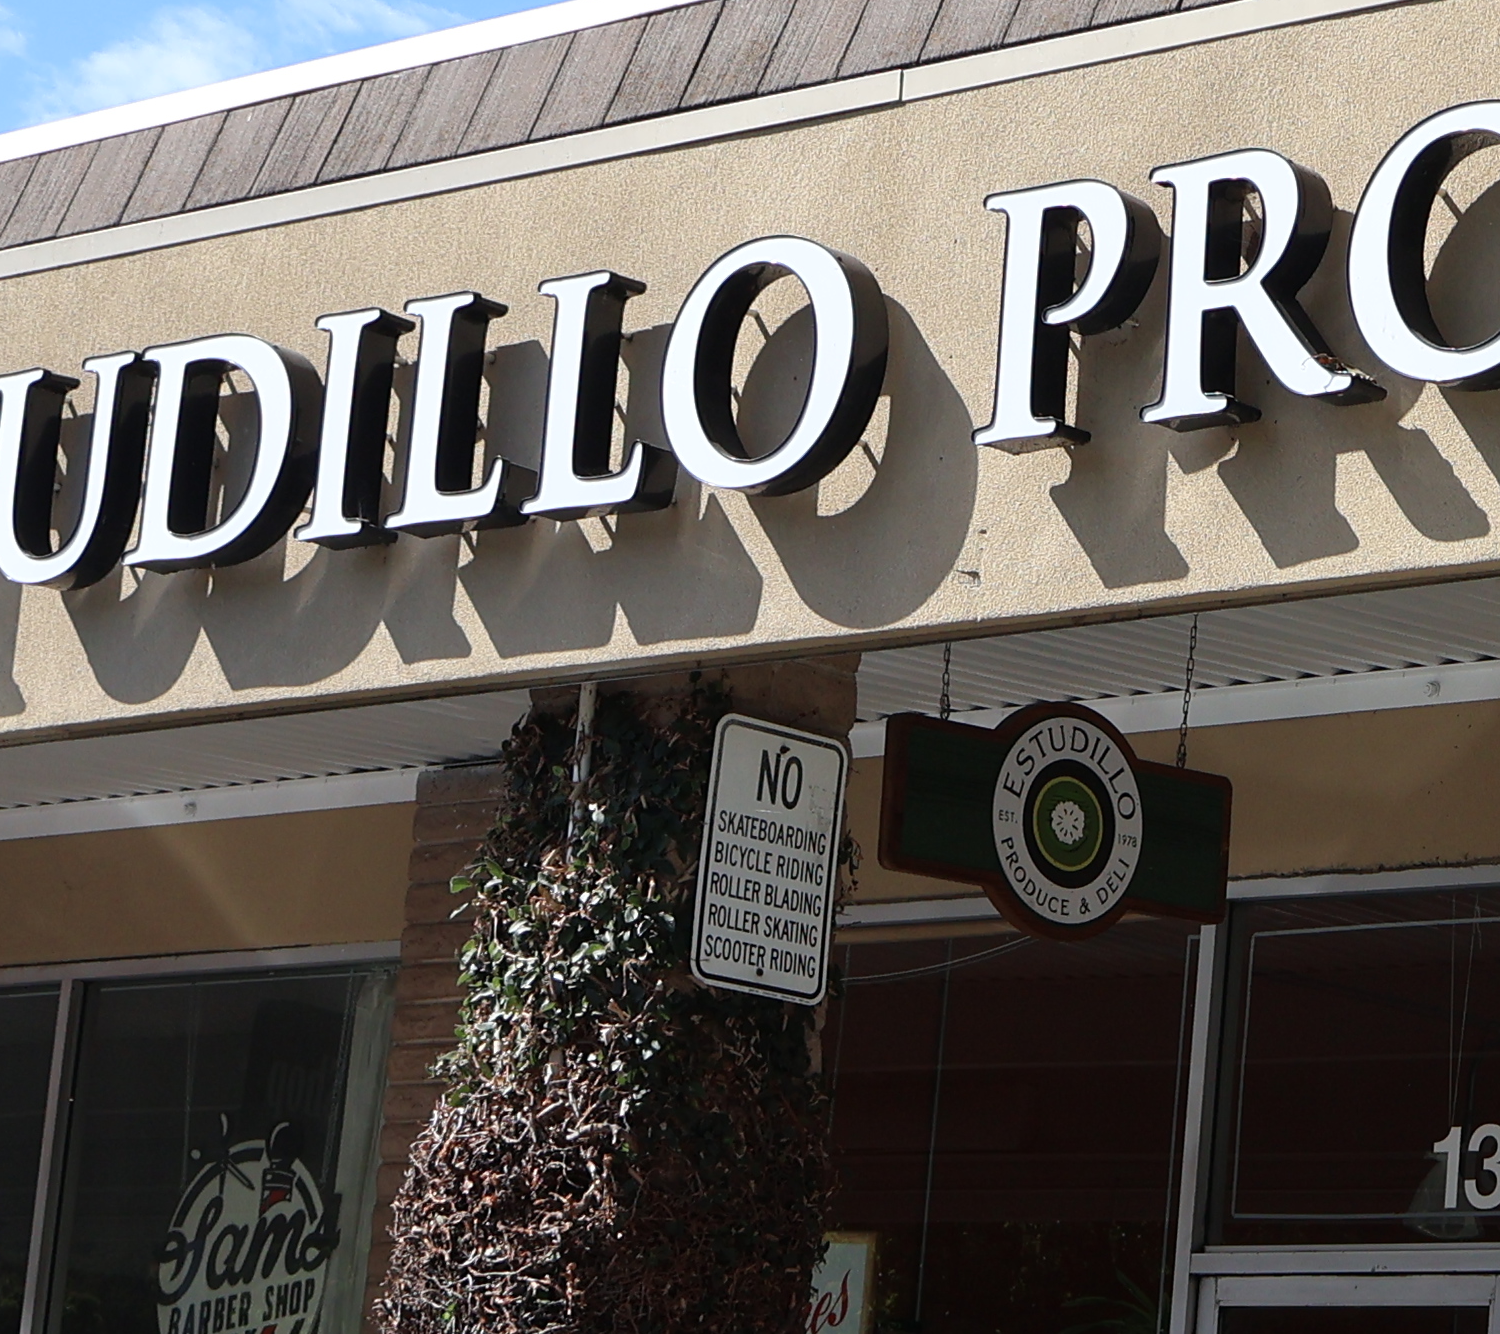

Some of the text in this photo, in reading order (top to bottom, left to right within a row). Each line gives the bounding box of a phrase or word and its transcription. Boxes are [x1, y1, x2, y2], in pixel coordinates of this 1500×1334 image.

[756, 748, 804, 810] NO
[1002, 724, 1137, 821] ESTUDILLO
[718, 809, 827, 856] SKATEBOARDING
[998, 809, 1019, 825] EST.
[714, 840, 824, 887] BICYCLE RIDING
[1117, 833, 1138, 849] 1978
[709, 871, 822, 918] ROLLER BLADING
[1000, 836, 1131, 916] PRODUCE & DELI
[707, 902, 819, 948] ROLLER SKATING
[703, 933, 816, 979] SCOOTER RIDING
[262, 1277, 315, 1322] SHOP
